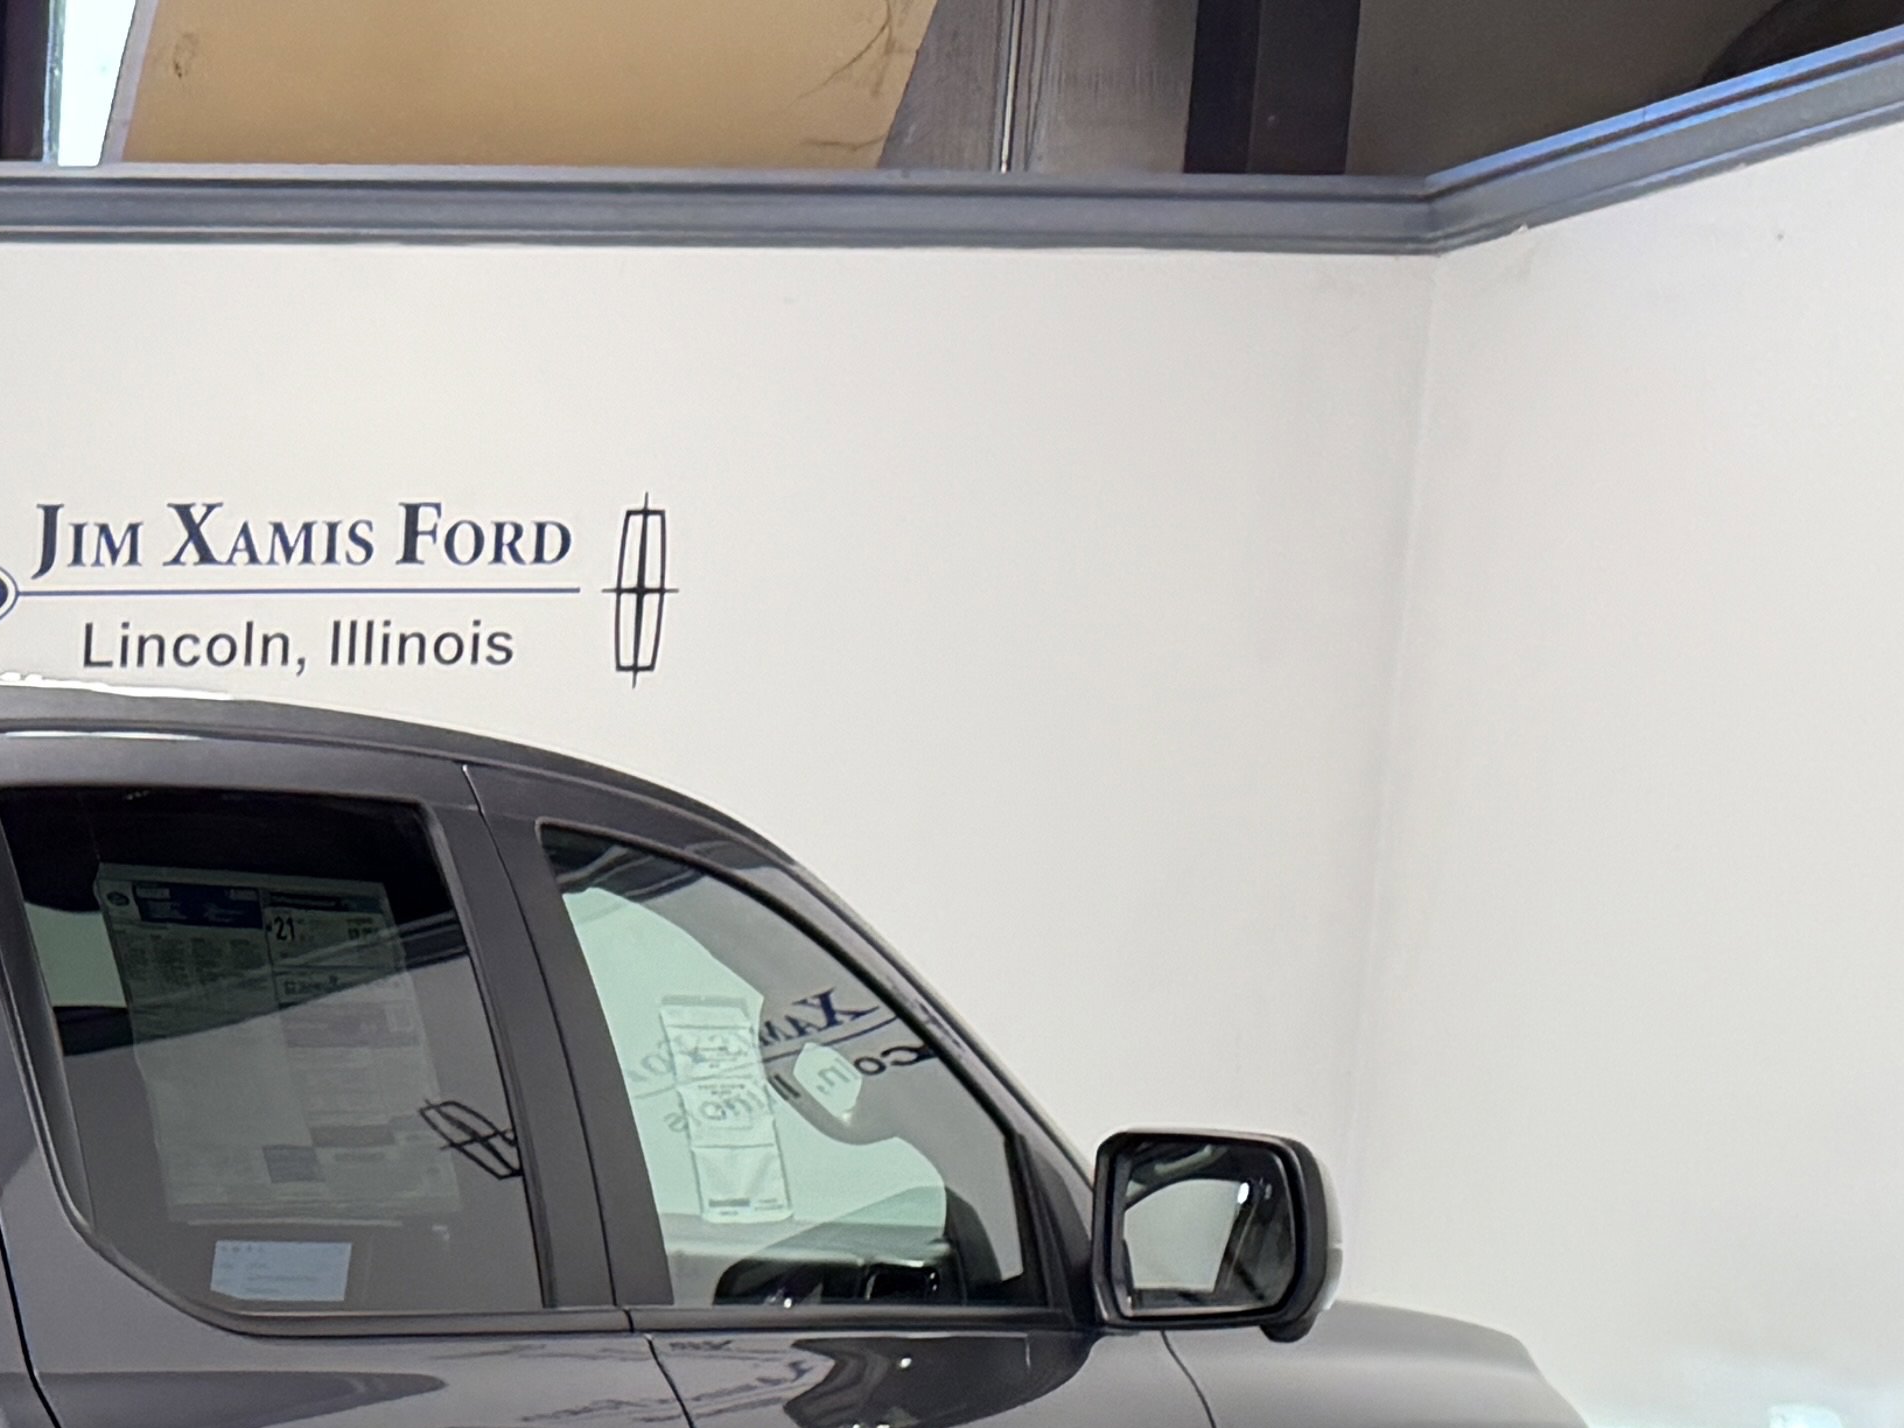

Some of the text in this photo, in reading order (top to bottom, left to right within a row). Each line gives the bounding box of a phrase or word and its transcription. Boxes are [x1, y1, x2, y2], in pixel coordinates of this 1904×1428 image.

[31, 502, 572, 580] JIM XAMIS FORD
[83, 619, 514, 676] Lincoln, Illinois
